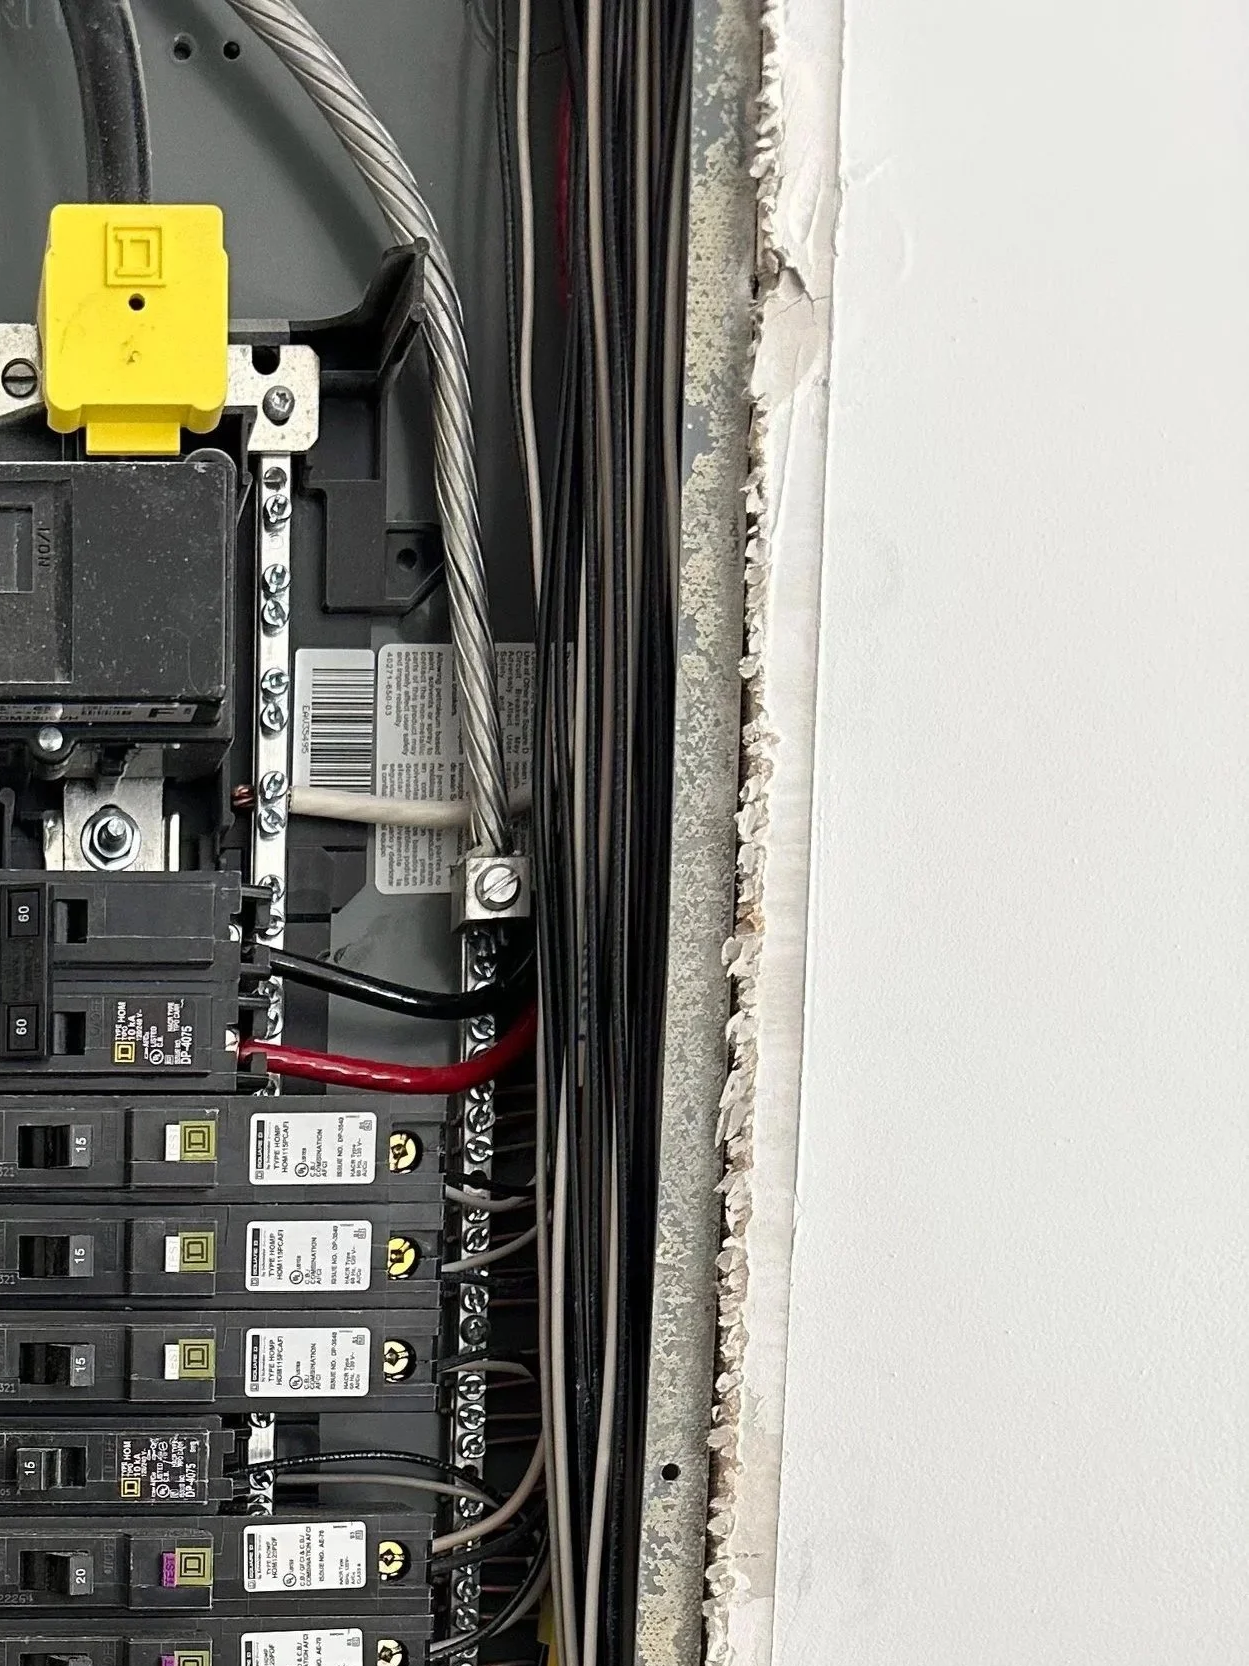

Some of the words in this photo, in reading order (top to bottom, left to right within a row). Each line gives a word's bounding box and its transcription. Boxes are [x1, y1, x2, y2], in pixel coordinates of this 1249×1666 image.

[435, 652, 443, 684] Allowing
[434, 688, 442, 728] petroleum
[18, 905, 30, 923] 60
[118, 1002, 126, 1022] HOM
[16, 1018, 28, 1036] 60
[128, 1016, 136, 1027] kA
[128, 1029, 136, 1040] 10
[180, 1026, 192, 1064] DP-4075
[75, 1137, 86, 1153] 15
[74, 1248, 85, 1264] 15
[75, 1357, 86, 1373] 15
[123, 1441, 132, 1460] HOM
[133, 1454, 141, 1464] kA
[24, 1461, 35, 1476] 15
[133, 1466, 141, 1476] 10
[185, 1463, 196, 1498] DP-4075
[75, 1568, 87, 1585] 20
[165, 1557, 176, 1588] TEST
